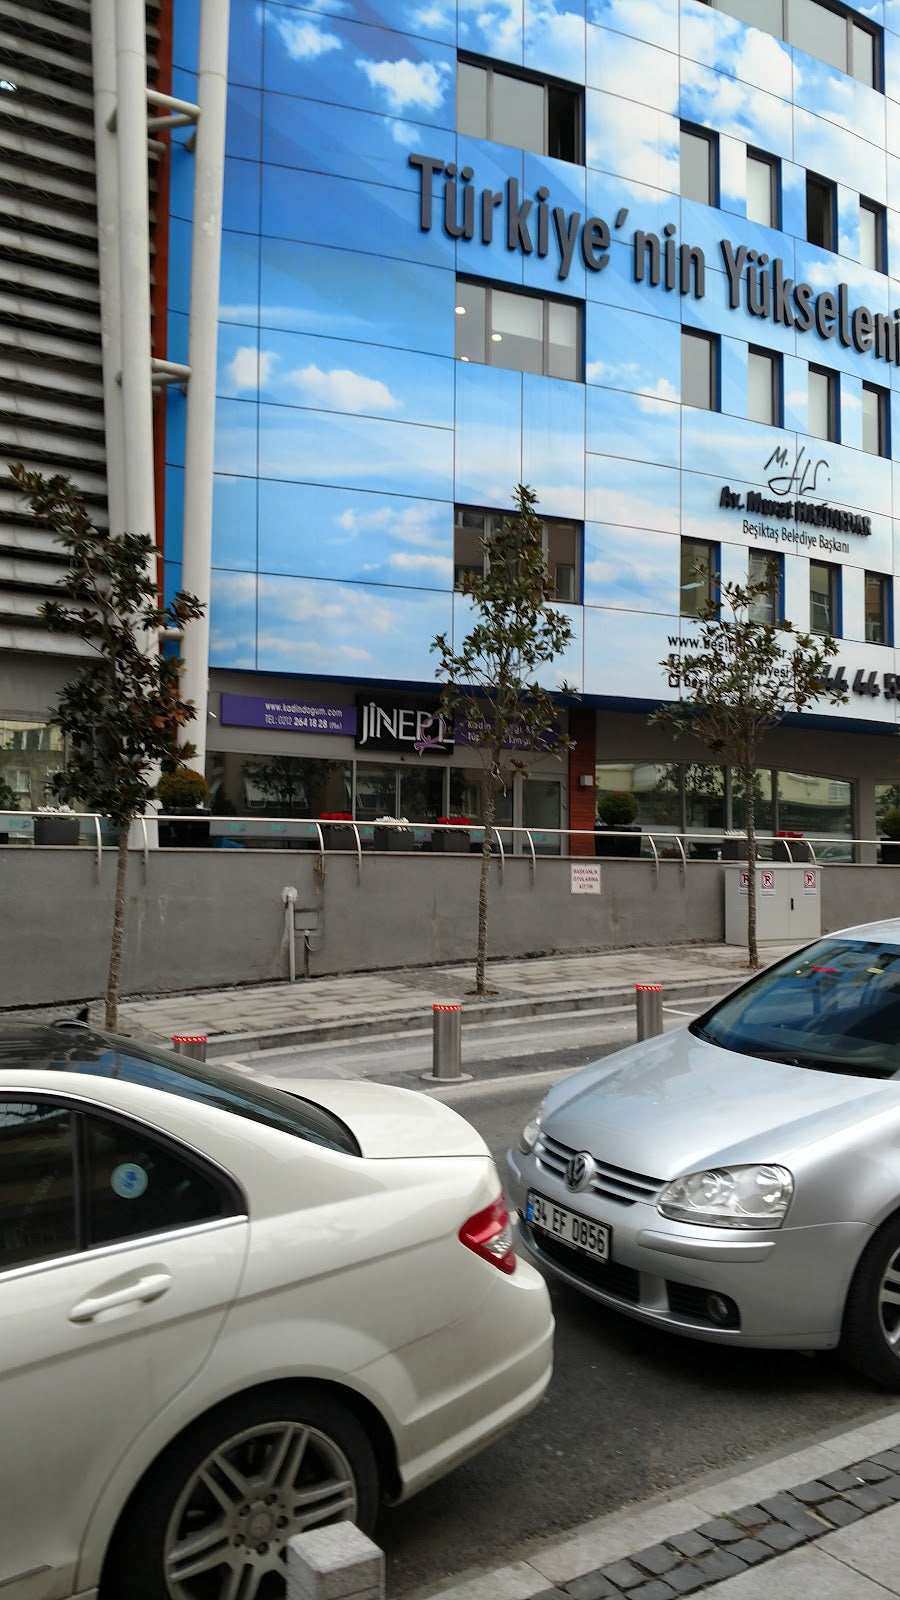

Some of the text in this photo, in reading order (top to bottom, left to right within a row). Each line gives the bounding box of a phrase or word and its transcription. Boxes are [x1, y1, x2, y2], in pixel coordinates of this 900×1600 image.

[409, 153, 705, 299] Türkiye'nin
[743, 519, 850, 553] Beşiktaş Belediye Başkanı
[534, 1198, 547, 1226] 34
[552, 1208, 567, 1234] EF
[572, 1217, 605, 1254] 0856
